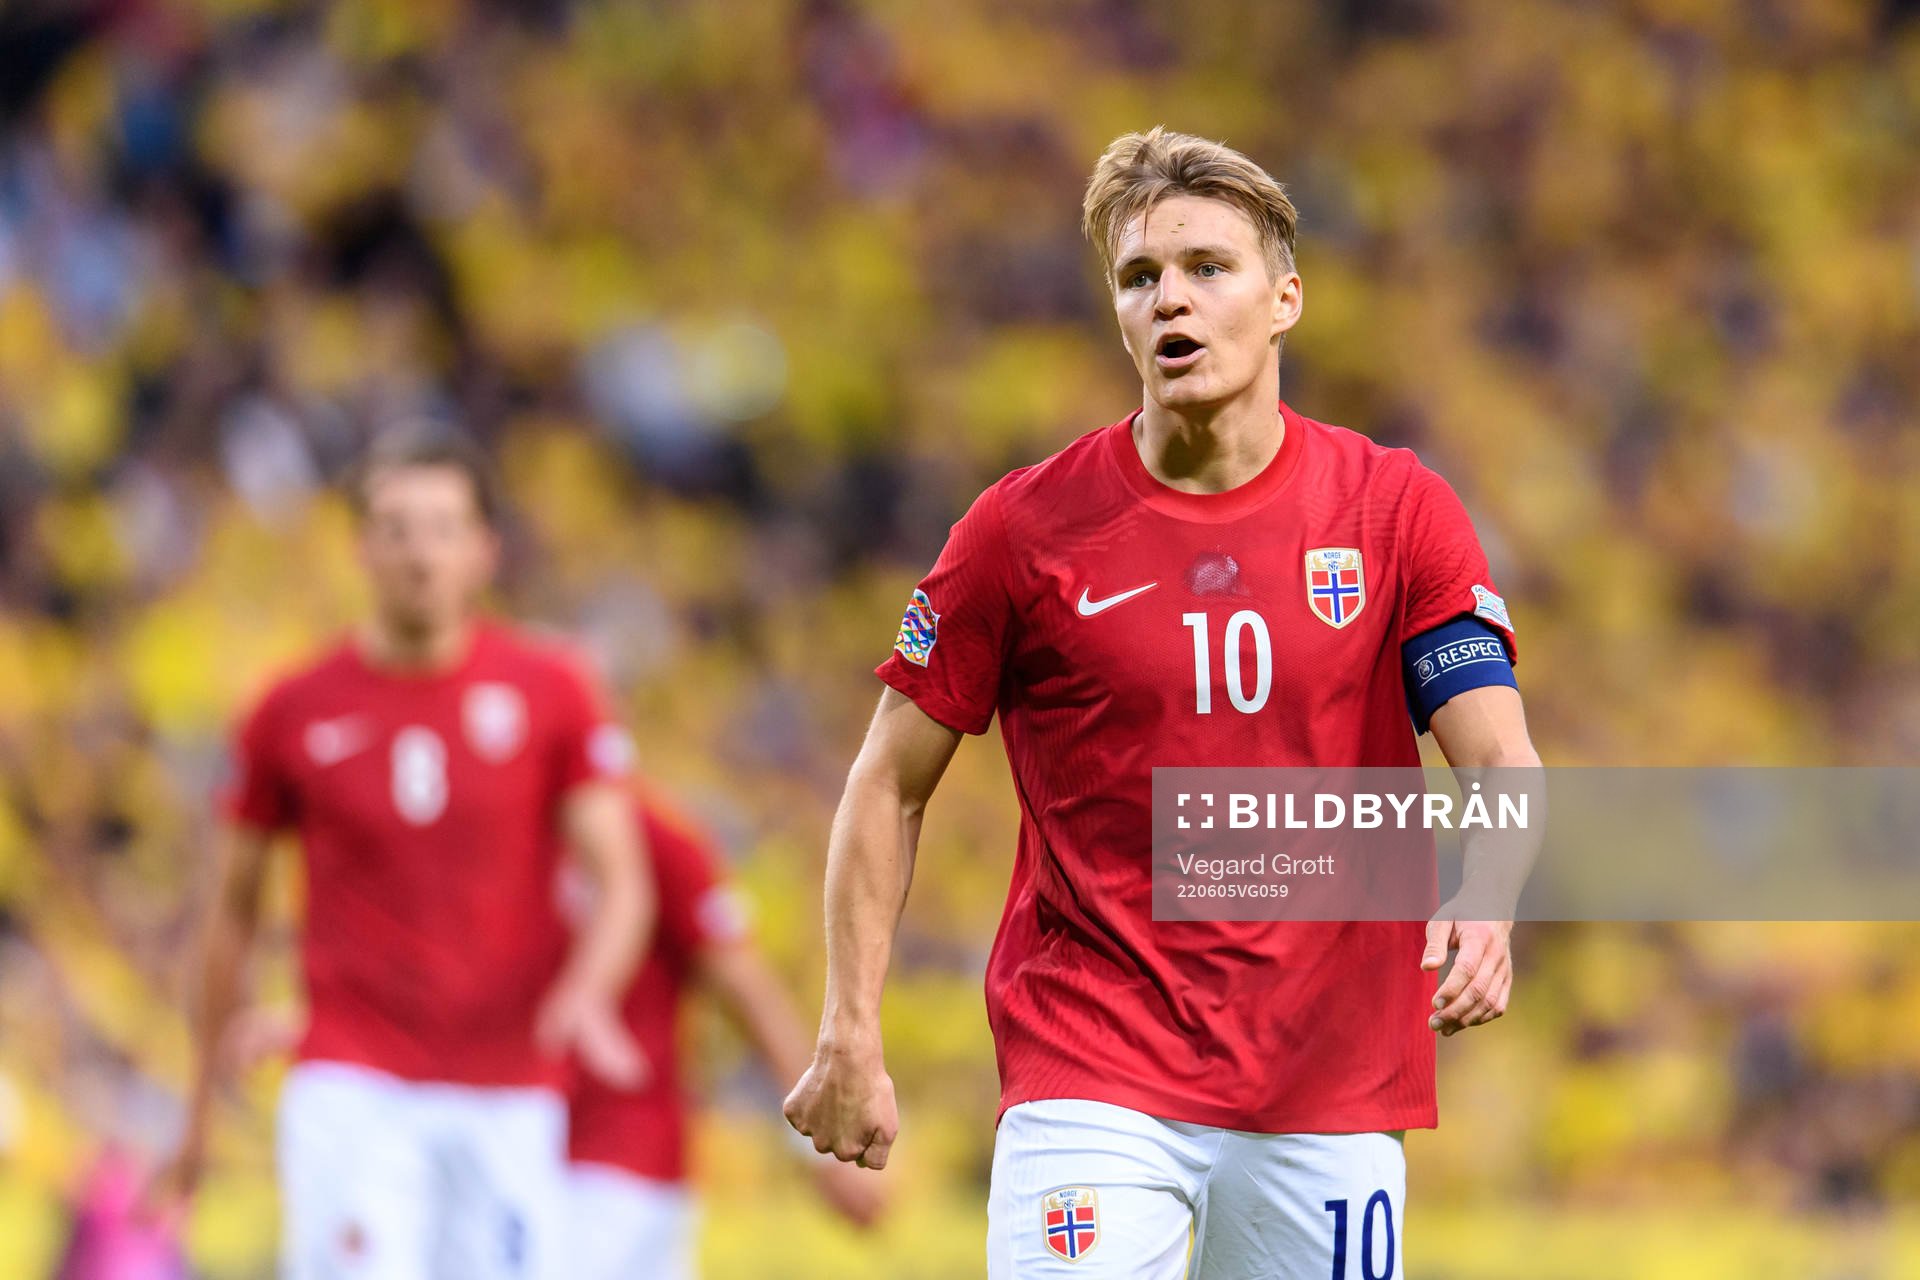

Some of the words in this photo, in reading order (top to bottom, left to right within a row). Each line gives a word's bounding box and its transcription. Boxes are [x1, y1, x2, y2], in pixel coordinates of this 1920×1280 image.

[1182, 610, 1272, 714] 10
[1437, 642, 1503, 667] RESPECT
[1325, 1189, 1394, 1280] 10
